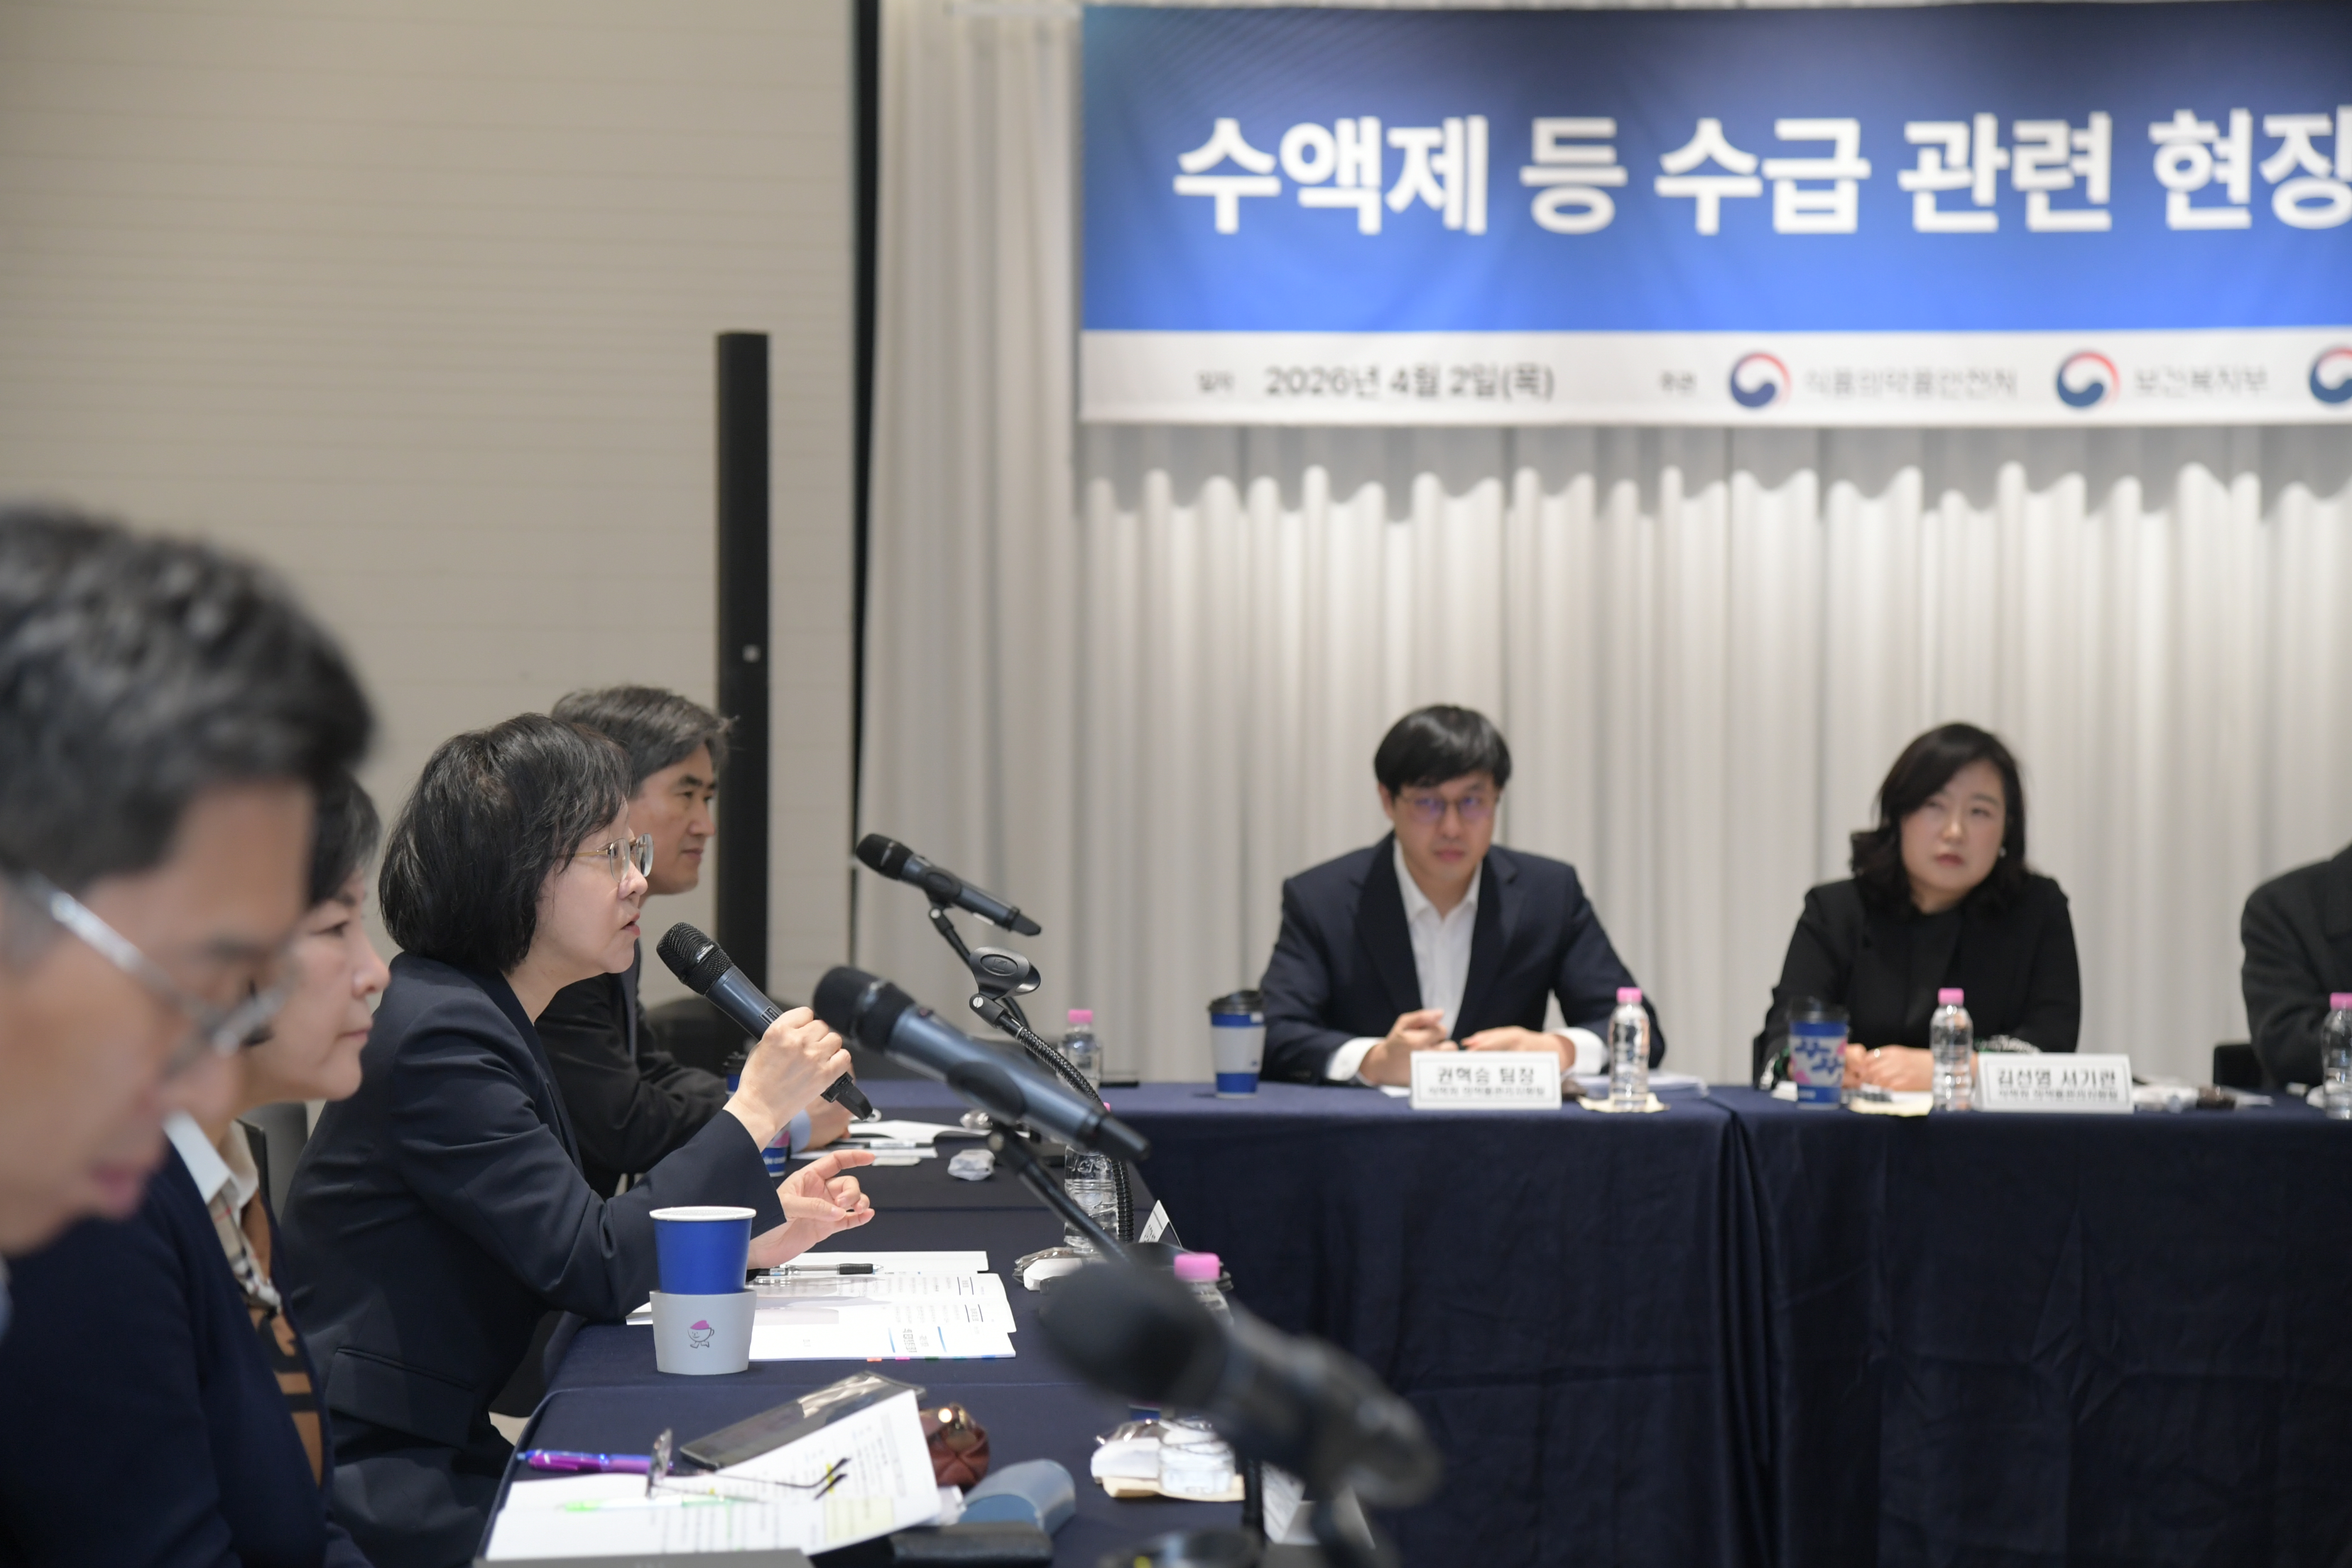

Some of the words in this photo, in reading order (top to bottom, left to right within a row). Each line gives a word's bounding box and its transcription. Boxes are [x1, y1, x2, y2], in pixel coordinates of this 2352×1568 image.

[1173, 115, 1489, 236] 수액제
[1520, 118, 1628, 234] 등
[1654, 117, 1872, 236] 수급
[1896, 112, 2113, 234] 관련
[2148, 105, 2352, 231] 현장
[1264, 366, 1380, 399] 2026년
[1388, 366, 1442, 398] 4월
[1449, 366, 1556, 401] 2일(목)
[1499, 1067, 1535, 1085] 팀장
